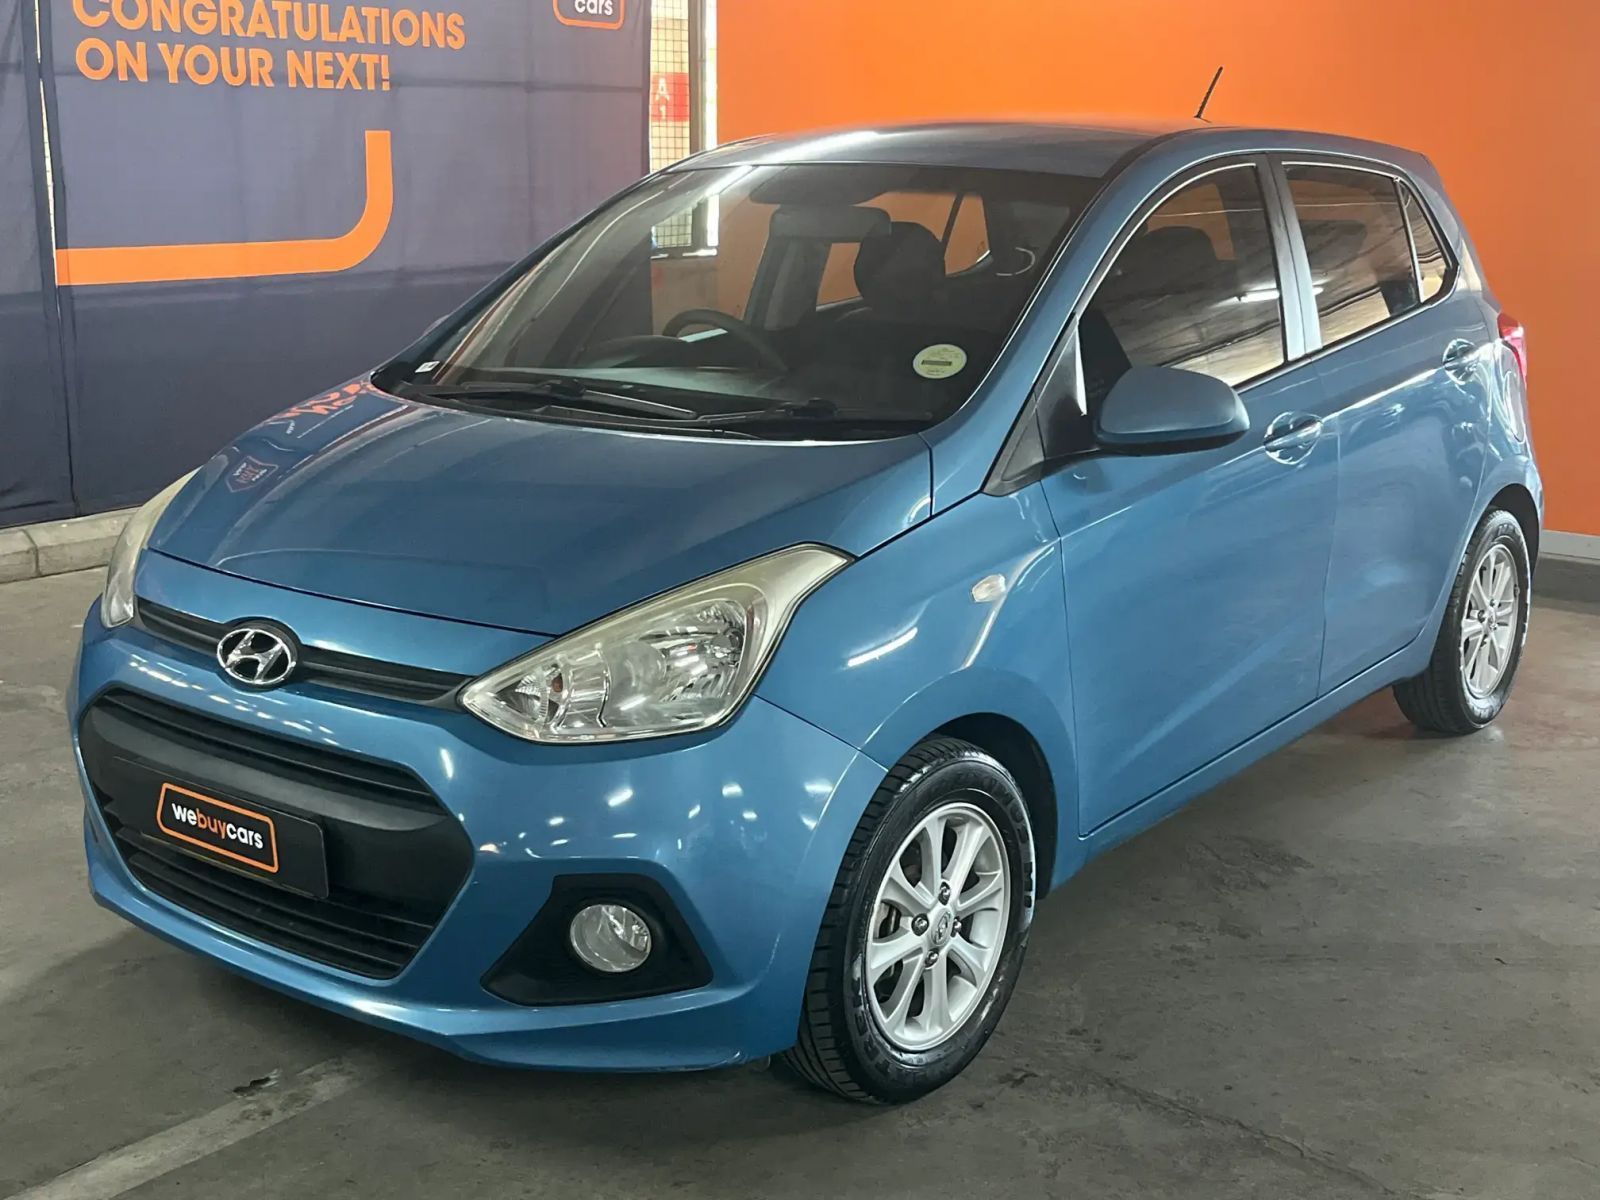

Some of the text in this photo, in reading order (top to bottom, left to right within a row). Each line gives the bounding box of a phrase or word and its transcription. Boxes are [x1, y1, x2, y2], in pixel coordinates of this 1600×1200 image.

[73, 0, 465, 49] CONGRATULATIONS
[574, 0, 613, 16] cars
[75, 37, 390, 91] ON YOUR NEXT!
[656, 77, 670, 101] A
[171, 803, 264, 849] webuycars
